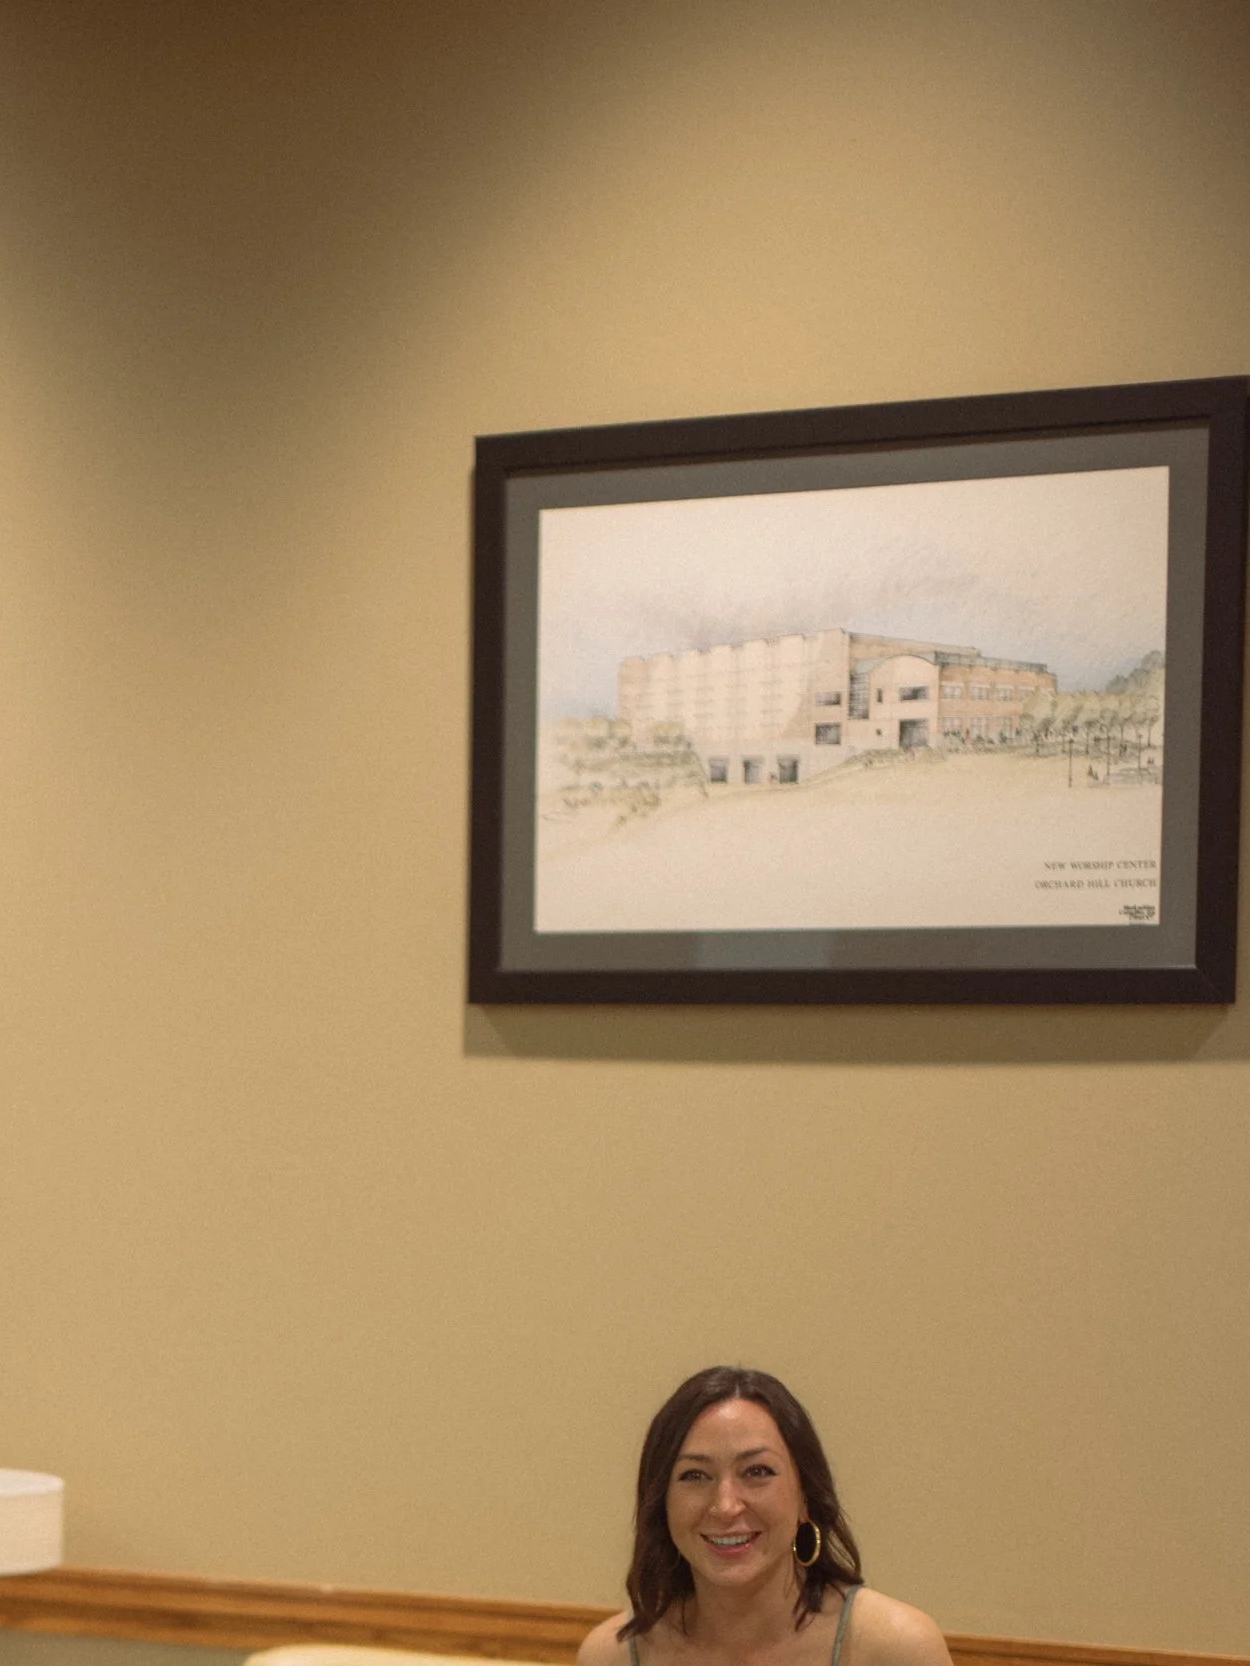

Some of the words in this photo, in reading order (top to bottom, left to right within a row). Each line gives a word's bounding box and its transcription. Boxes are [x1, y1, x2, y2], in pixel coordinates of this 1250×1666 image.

[1044, 861, 1066, 870] NEW
[1070, 860, 1114, 870] WORSHIP
[1117, 860, 1157, 870] CENTER
[1034, 879, 1084, 889] ORCHARD
[1087, 879, 1110, 888] HILL
[1114, 878, 1157, 888] CHURCH
